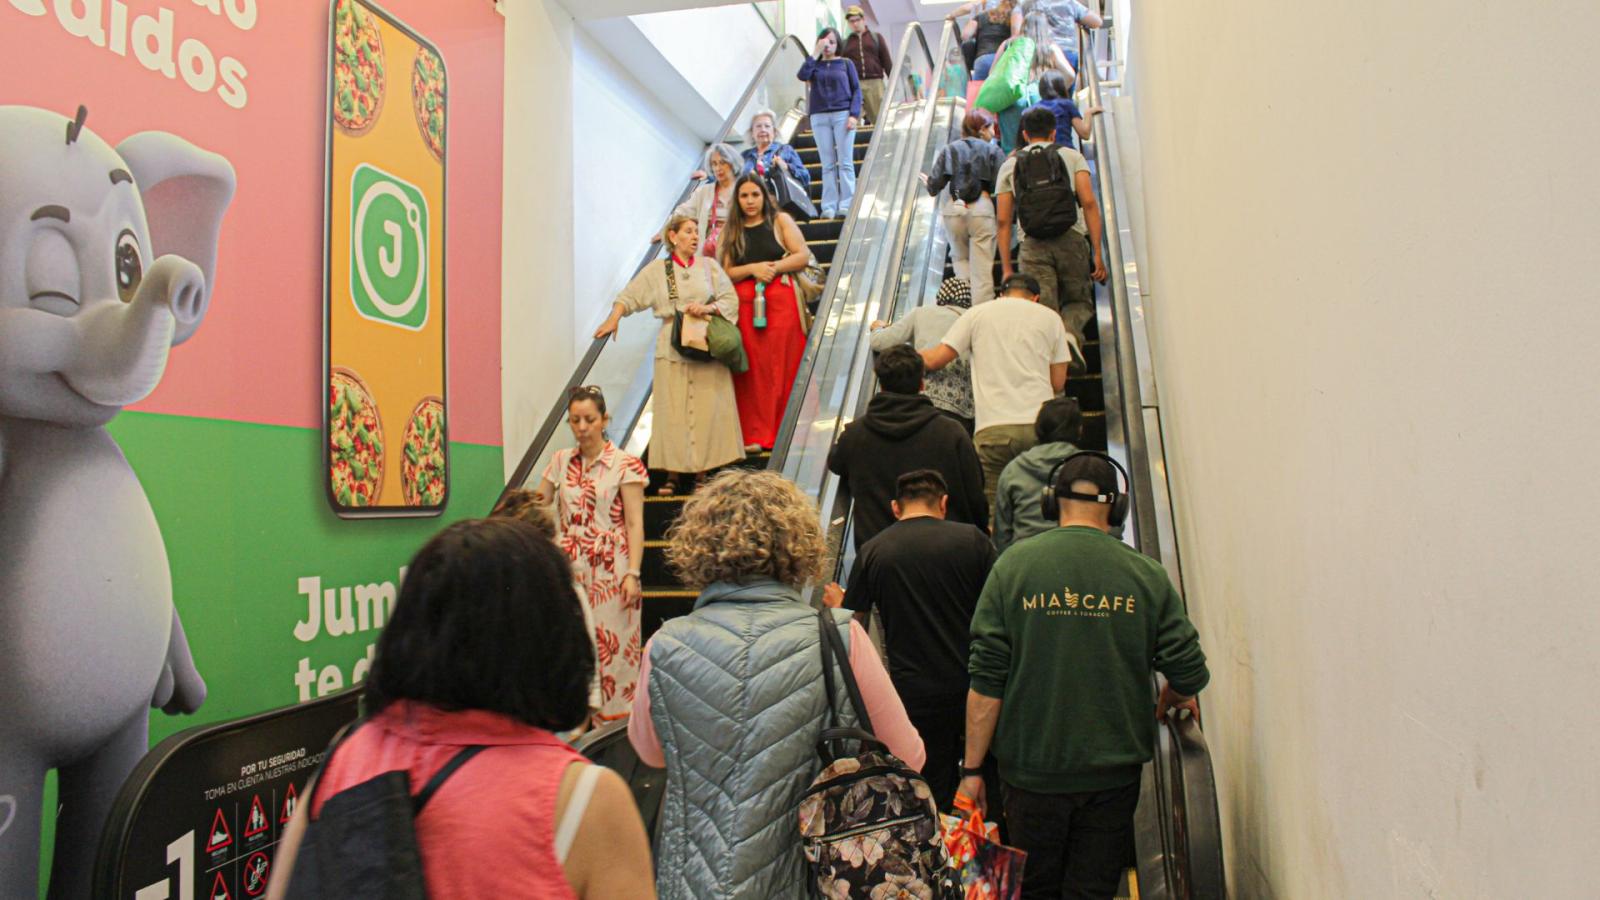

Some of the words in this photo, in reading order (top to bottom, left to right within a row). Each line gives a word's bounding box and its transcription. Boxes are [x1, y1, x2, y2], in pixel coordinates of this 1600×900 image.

[293, 564, 408, 642] Jum
[1022, 593, 1061, 611] MIA
[1082, 594, 1135, 613] CAFÉ
[295, 657, 344, 702] te
[204, 786, 226, 801] TOMA
[227, 782, 237, 793] EN
[238, 772, 264, 790] CUENTA
[265, 762, 297, 780] NUESTRAS
[241, 762, 256, 777] POR
[258, 759, 267, 770] TU
[268, 747, 306, 768] SEGURIDAD
